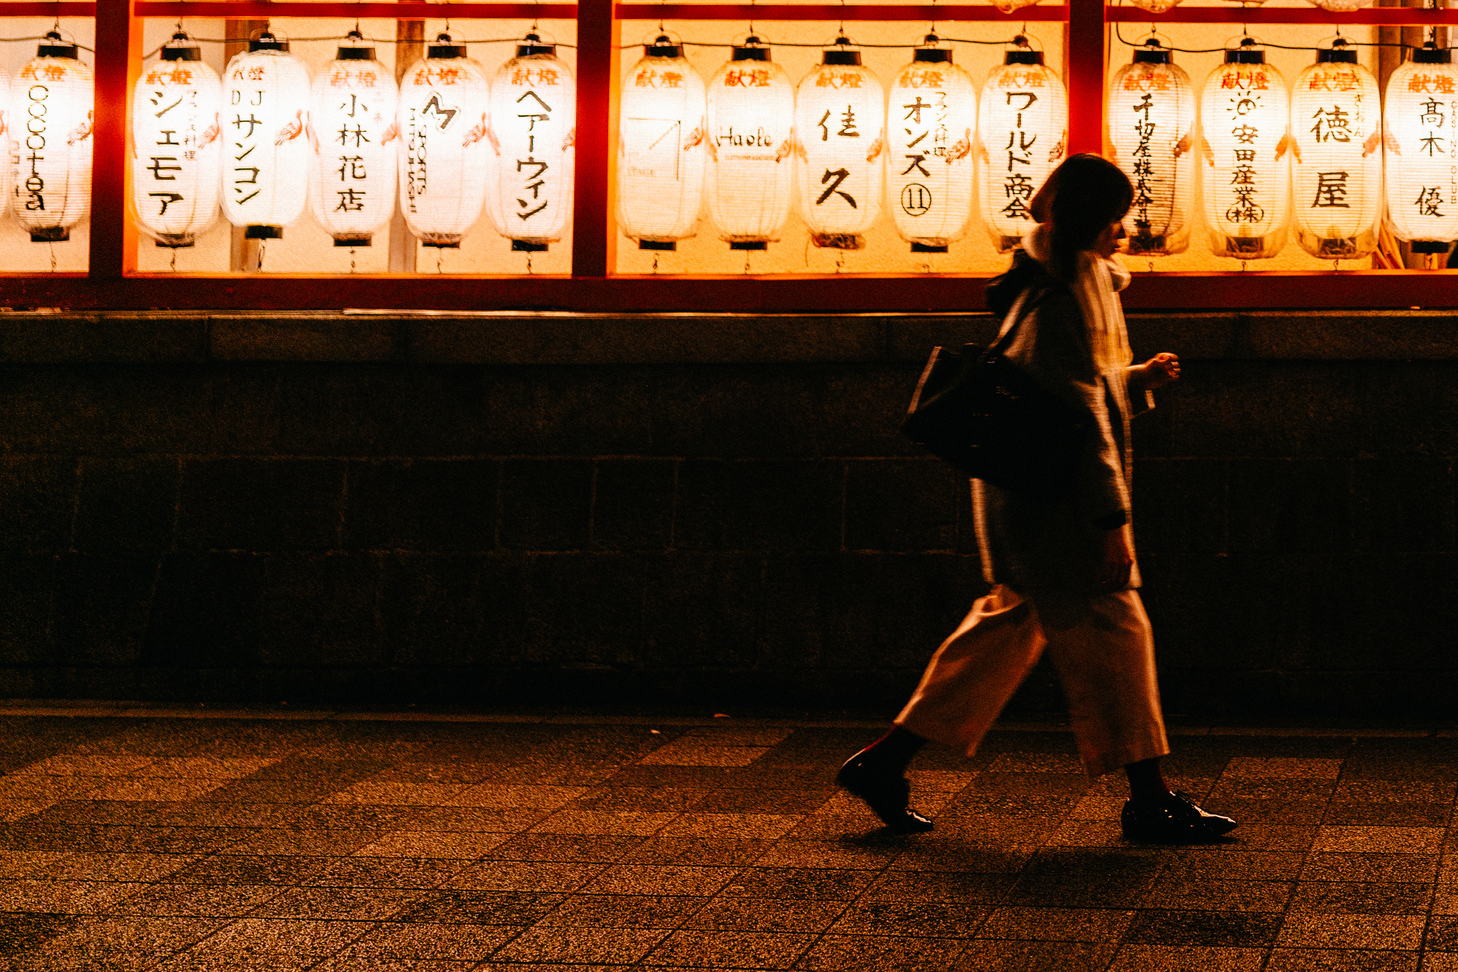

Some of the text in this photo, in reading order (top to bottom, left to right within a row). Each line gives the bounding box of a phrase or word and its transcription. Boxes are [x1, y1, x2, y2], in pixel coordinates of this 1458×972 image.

[231, 90, 267, 107] DJ
[1221, 71, 1270, 91] 献燈
[1408, 73, 1456, 94] 献燈
[146, 91, 185, 216] シェモア
[231, 113, 263, 206] サンコン
[333, 93, 372, 213] 小林花店
[1001, 91, 1038, 221] ワールド商会
[1310, 104, 1353, 209] 徳屋
